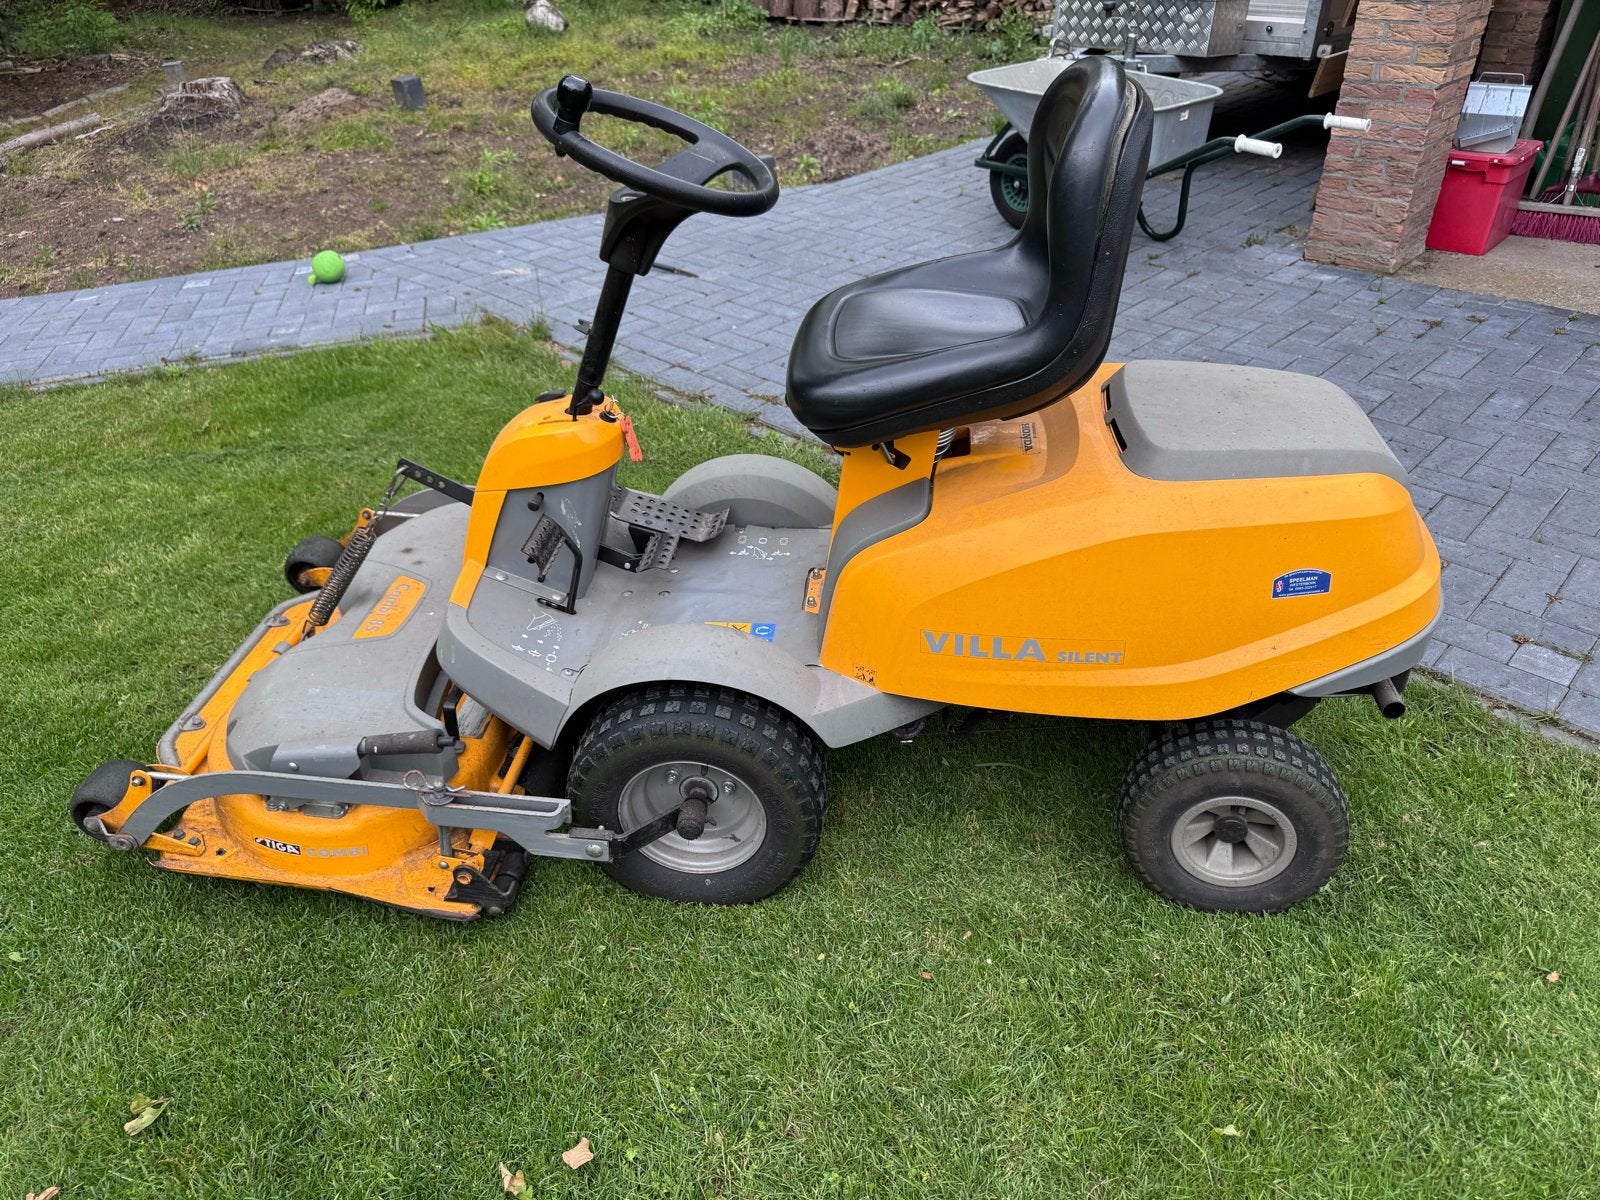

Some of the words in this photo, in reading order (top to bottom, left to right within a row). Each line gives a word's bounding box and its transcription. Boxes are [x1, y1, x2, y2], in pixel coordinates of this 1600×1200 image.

[1021, 423, 1033, 452] HONDA
[1289, 576, 1319, 584] SPEELMAN
[376, 583, 411, 617] Combi
[923, 630, 1047, 662] VILLA
[1057, 651, 1124, 664] SILENT
[254, 837, 301, 855] STIGA
[305, 846, 368, 858] COMBI
